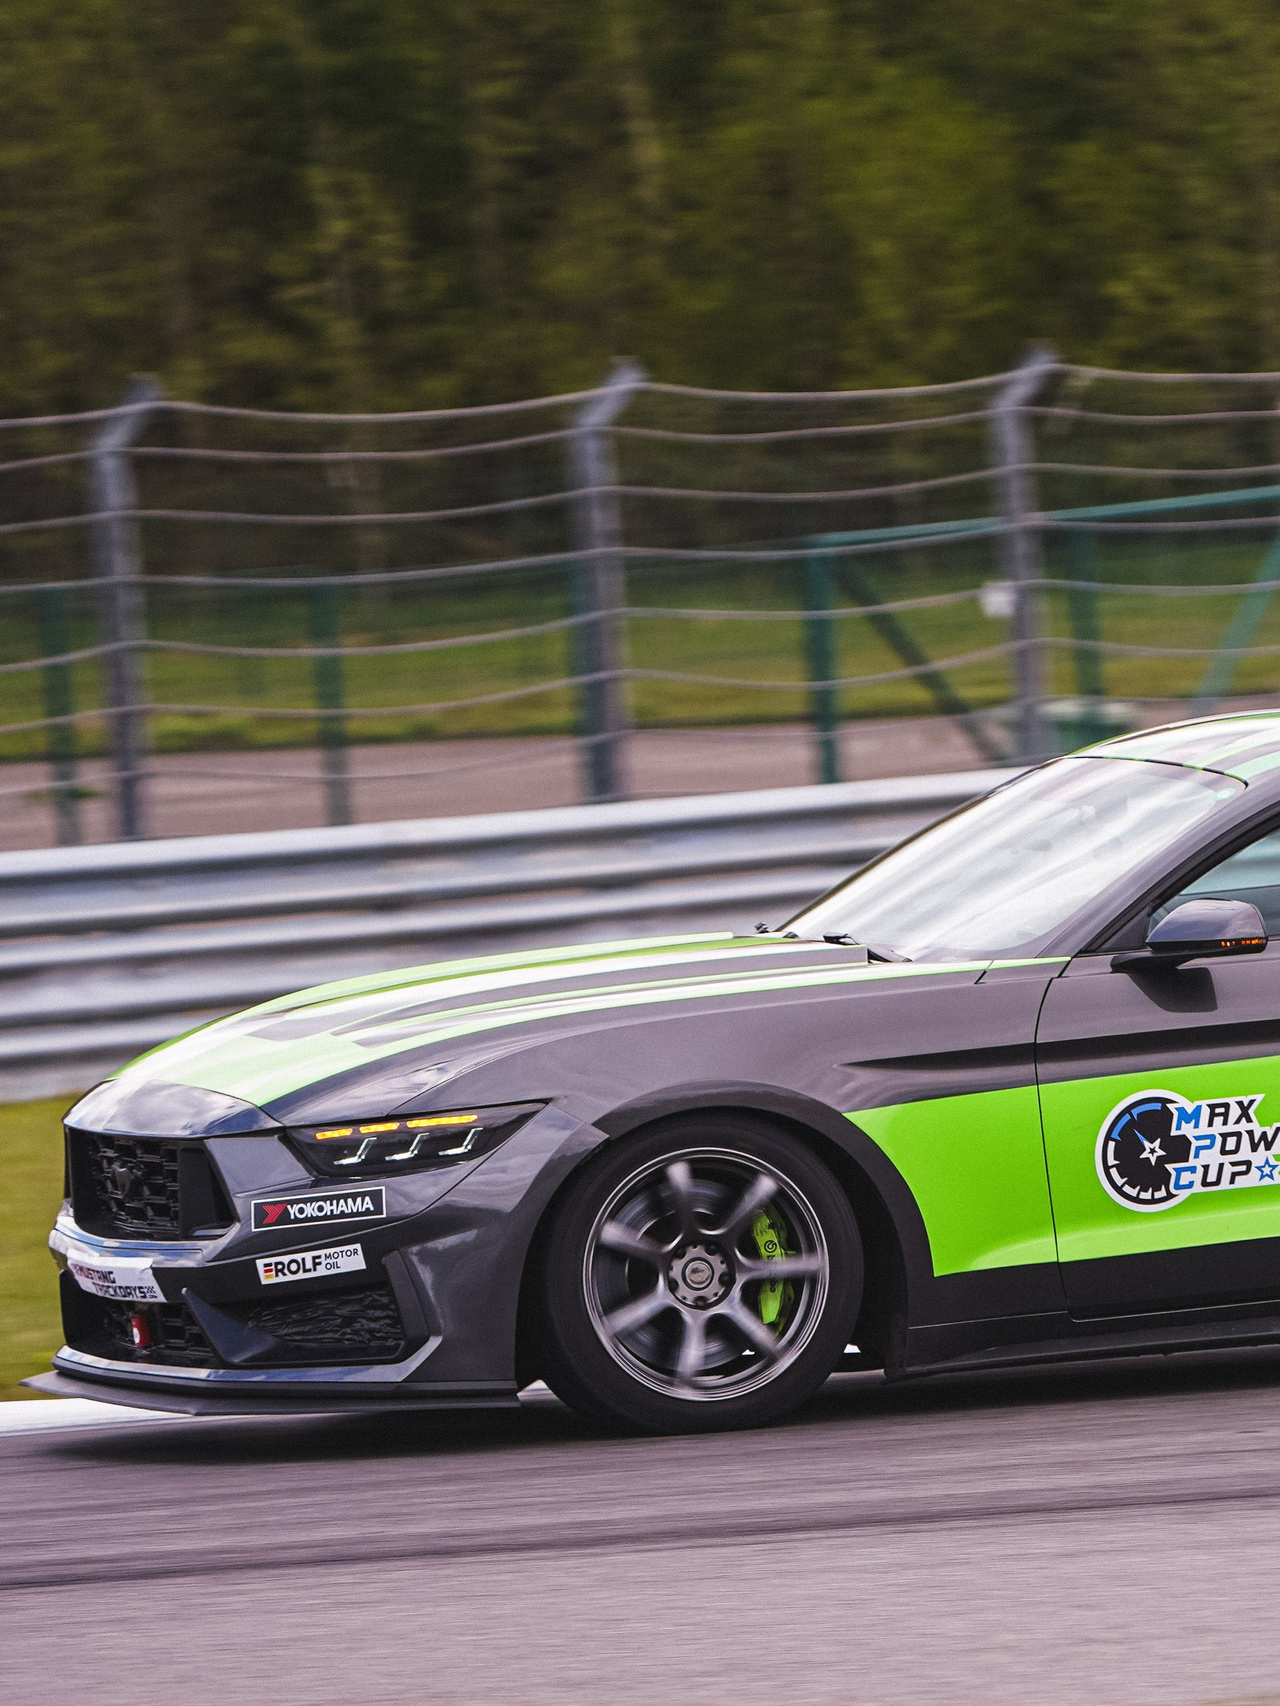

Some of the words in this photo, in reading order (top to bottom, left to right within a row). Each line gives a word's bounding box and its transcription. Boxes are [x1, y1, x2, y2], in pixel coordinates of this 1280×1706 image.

[1174, 1098, 1256, 1131] MAX
[1173, 1160, 1253, 1191] CUP
[287, 1196, 375, 1220] YOKOHAMA
[324, 1248, 359, 1261] MOTOR
[324, 1261, 341, 1271] OIL
[274, 1255, 322, 1278] ROLF
[92, 1281, 147, 1299] TRACKDAYS
